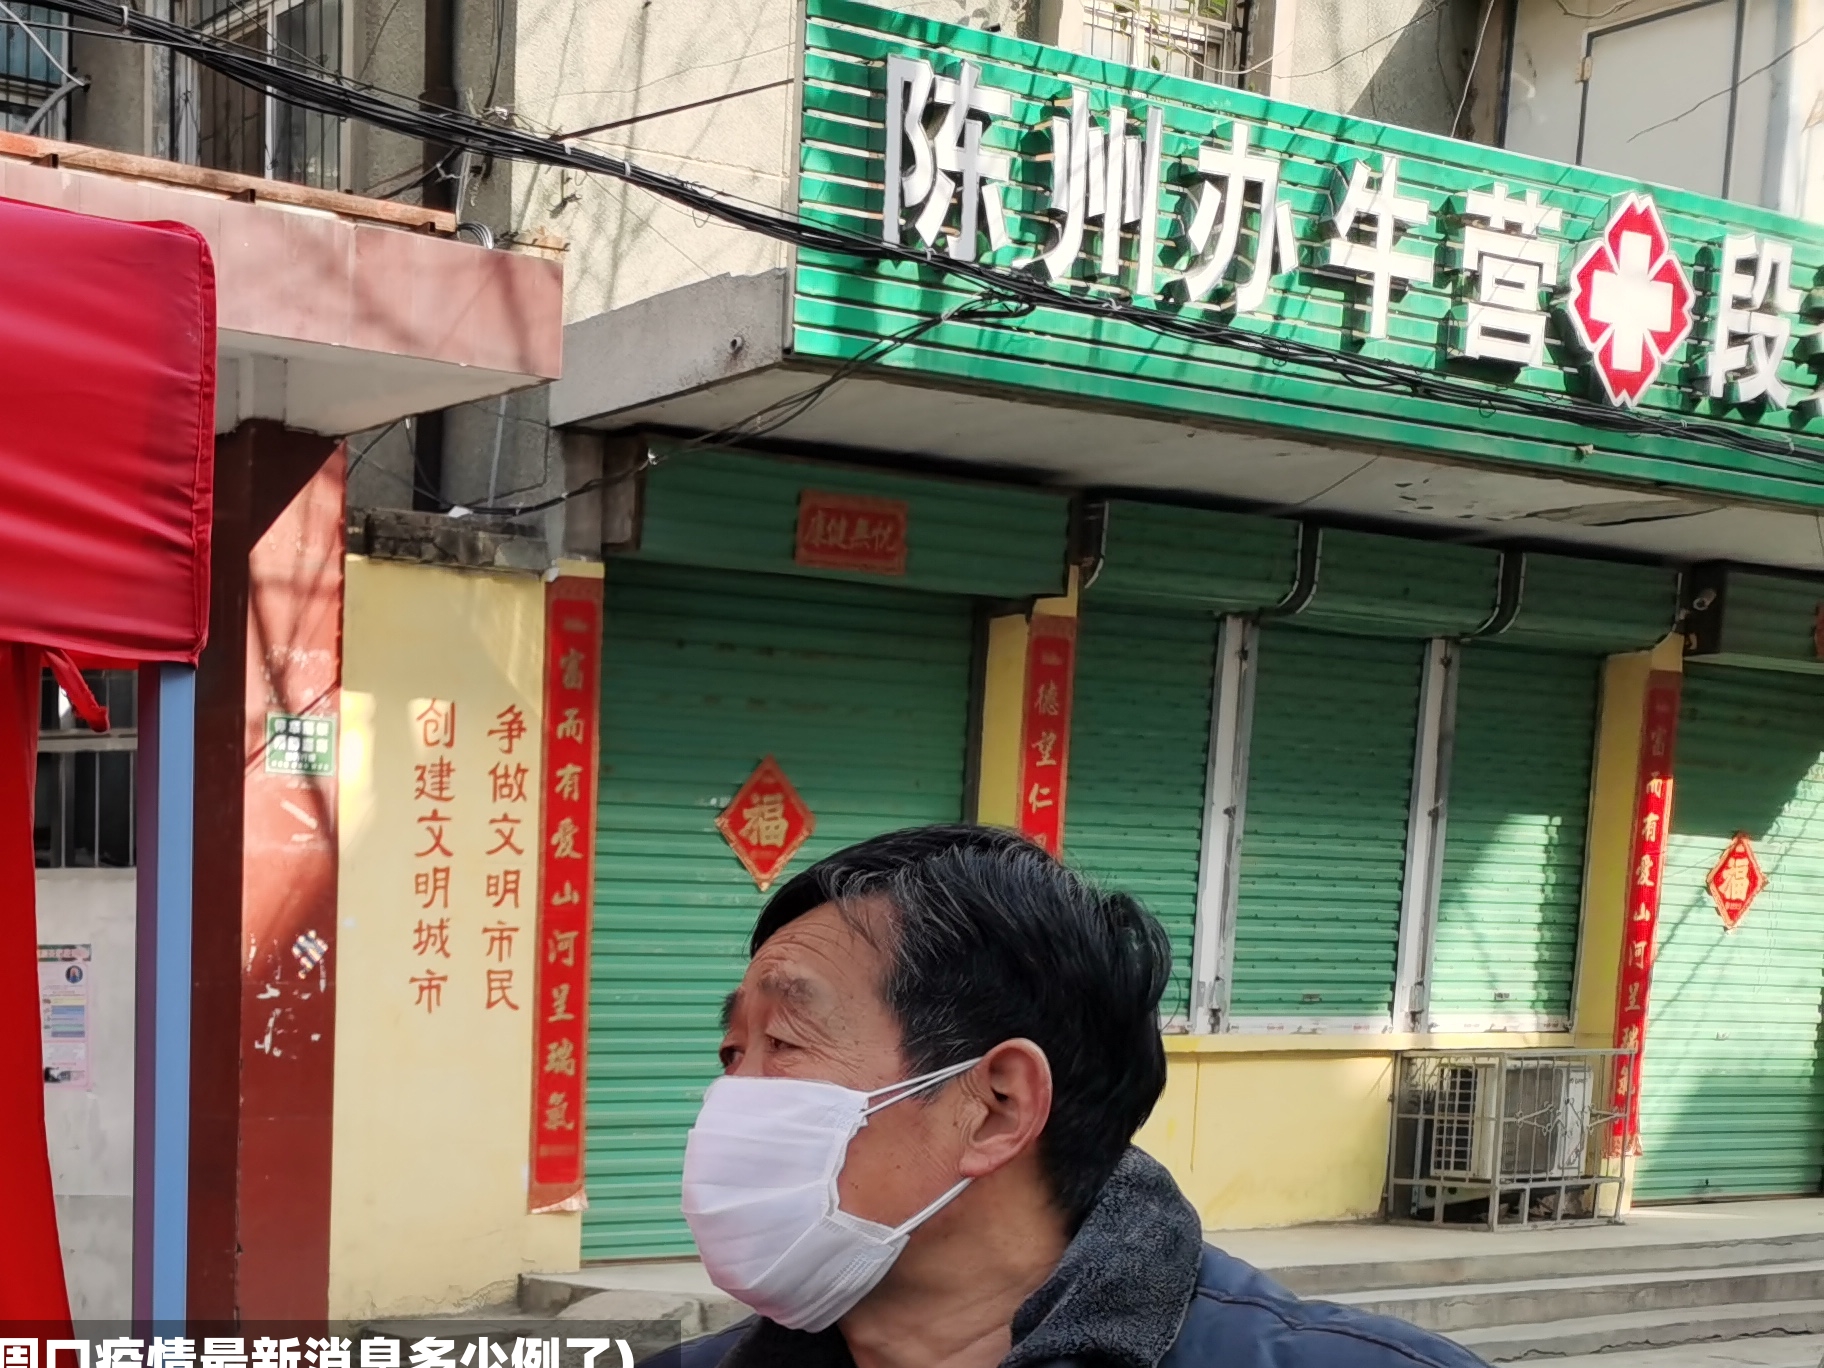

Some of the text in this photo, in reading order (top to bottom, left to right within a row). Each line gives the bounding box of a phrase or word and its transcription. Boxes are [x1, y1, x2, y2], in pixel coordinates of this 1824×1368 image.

[882, 53, 1824, 414] 陈州办牛营 段
[408, 697, 456, 1014] 创建文明城市
[481, 703, 530, 1011] 争做文明市民
[738, 793, 789, 848] 福
[1718, 857, 1750, 901] 福
